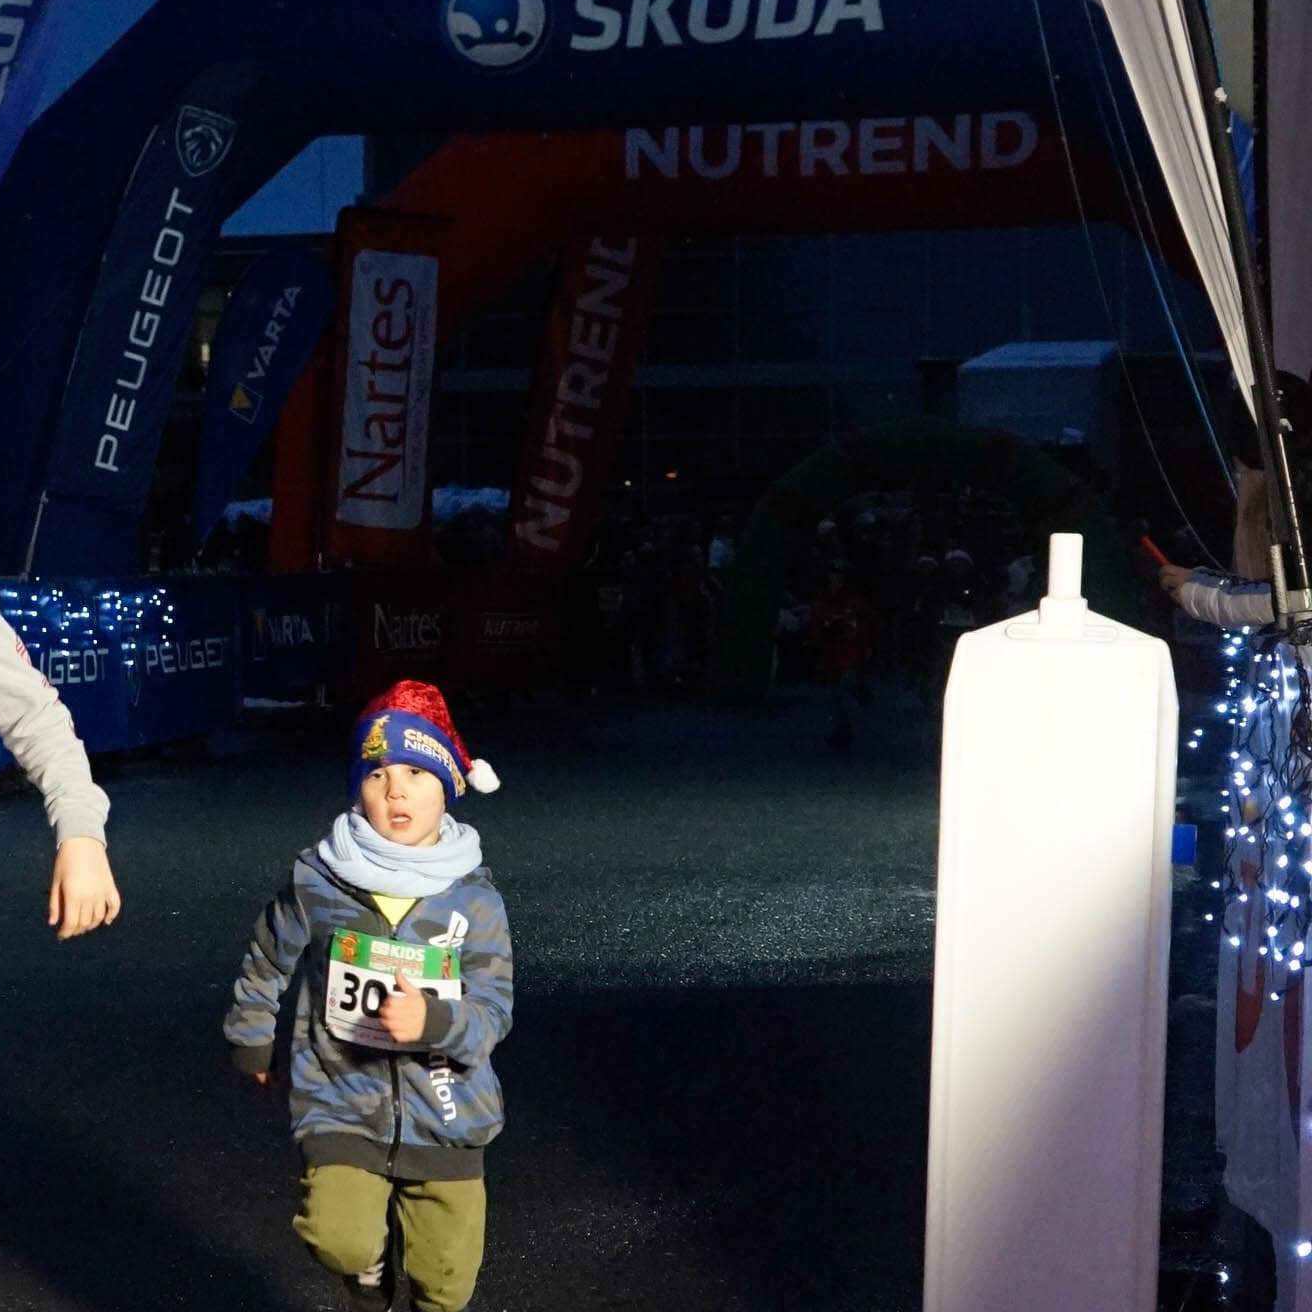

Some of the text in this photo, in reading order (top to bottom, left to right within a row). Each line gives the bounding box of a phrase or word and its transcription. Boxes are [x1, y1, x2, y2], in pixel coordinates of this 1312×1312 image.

[625, 110, 1039, 180] NUTREND
[94, 187, 194, 472] PEUGEOT
[245, 286, 304, 378] VARTA
[344, 277, 414, 504] Nartes
[40, 648, 110, 685] GEOT
[391, 945, 425, 962] KIDS
[339, 972, 438, 1018] 30
